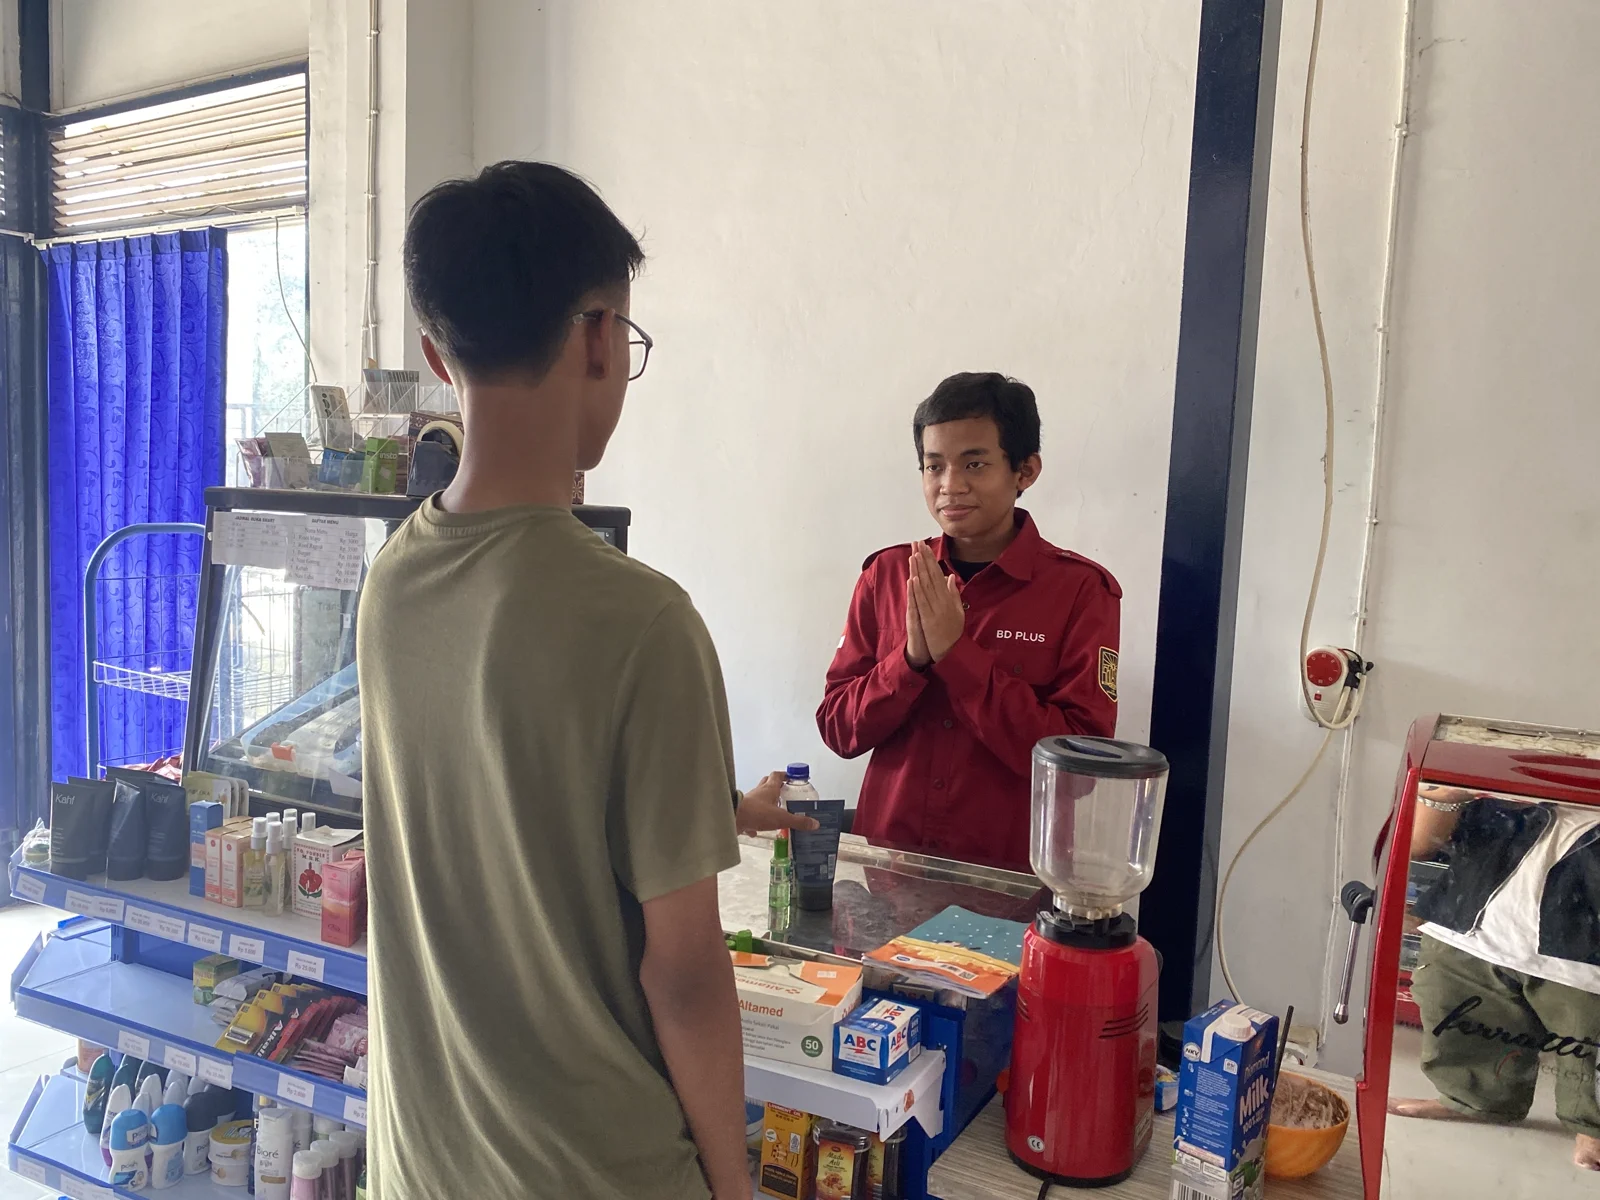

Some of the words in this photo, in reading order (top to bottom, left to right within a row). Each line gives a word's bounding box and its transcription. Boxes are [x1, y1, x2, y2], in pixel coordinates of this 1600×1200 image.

[996, 630, 1012, 639] BD
[1015, 631, 1046, 642] PLUS
[55, 793, 75, 805] Kahf
[151, 793, 170, 804] Kahf
[735, 978, 784, 991] Altame
[739, 1000, 784, 1017] Altamed
[884, 1006, 906, 1021] ABC
[805, 1040, 818, 1050] 50
[844, 1034, 876, 1052] ABC
[890, 1027, 906, 1050] ABC
[1240, 1074, 1270, 1126] Milk
[257, 1145, 279, 1158] Bioré
[828, 1152, 844, 1160] Madu
